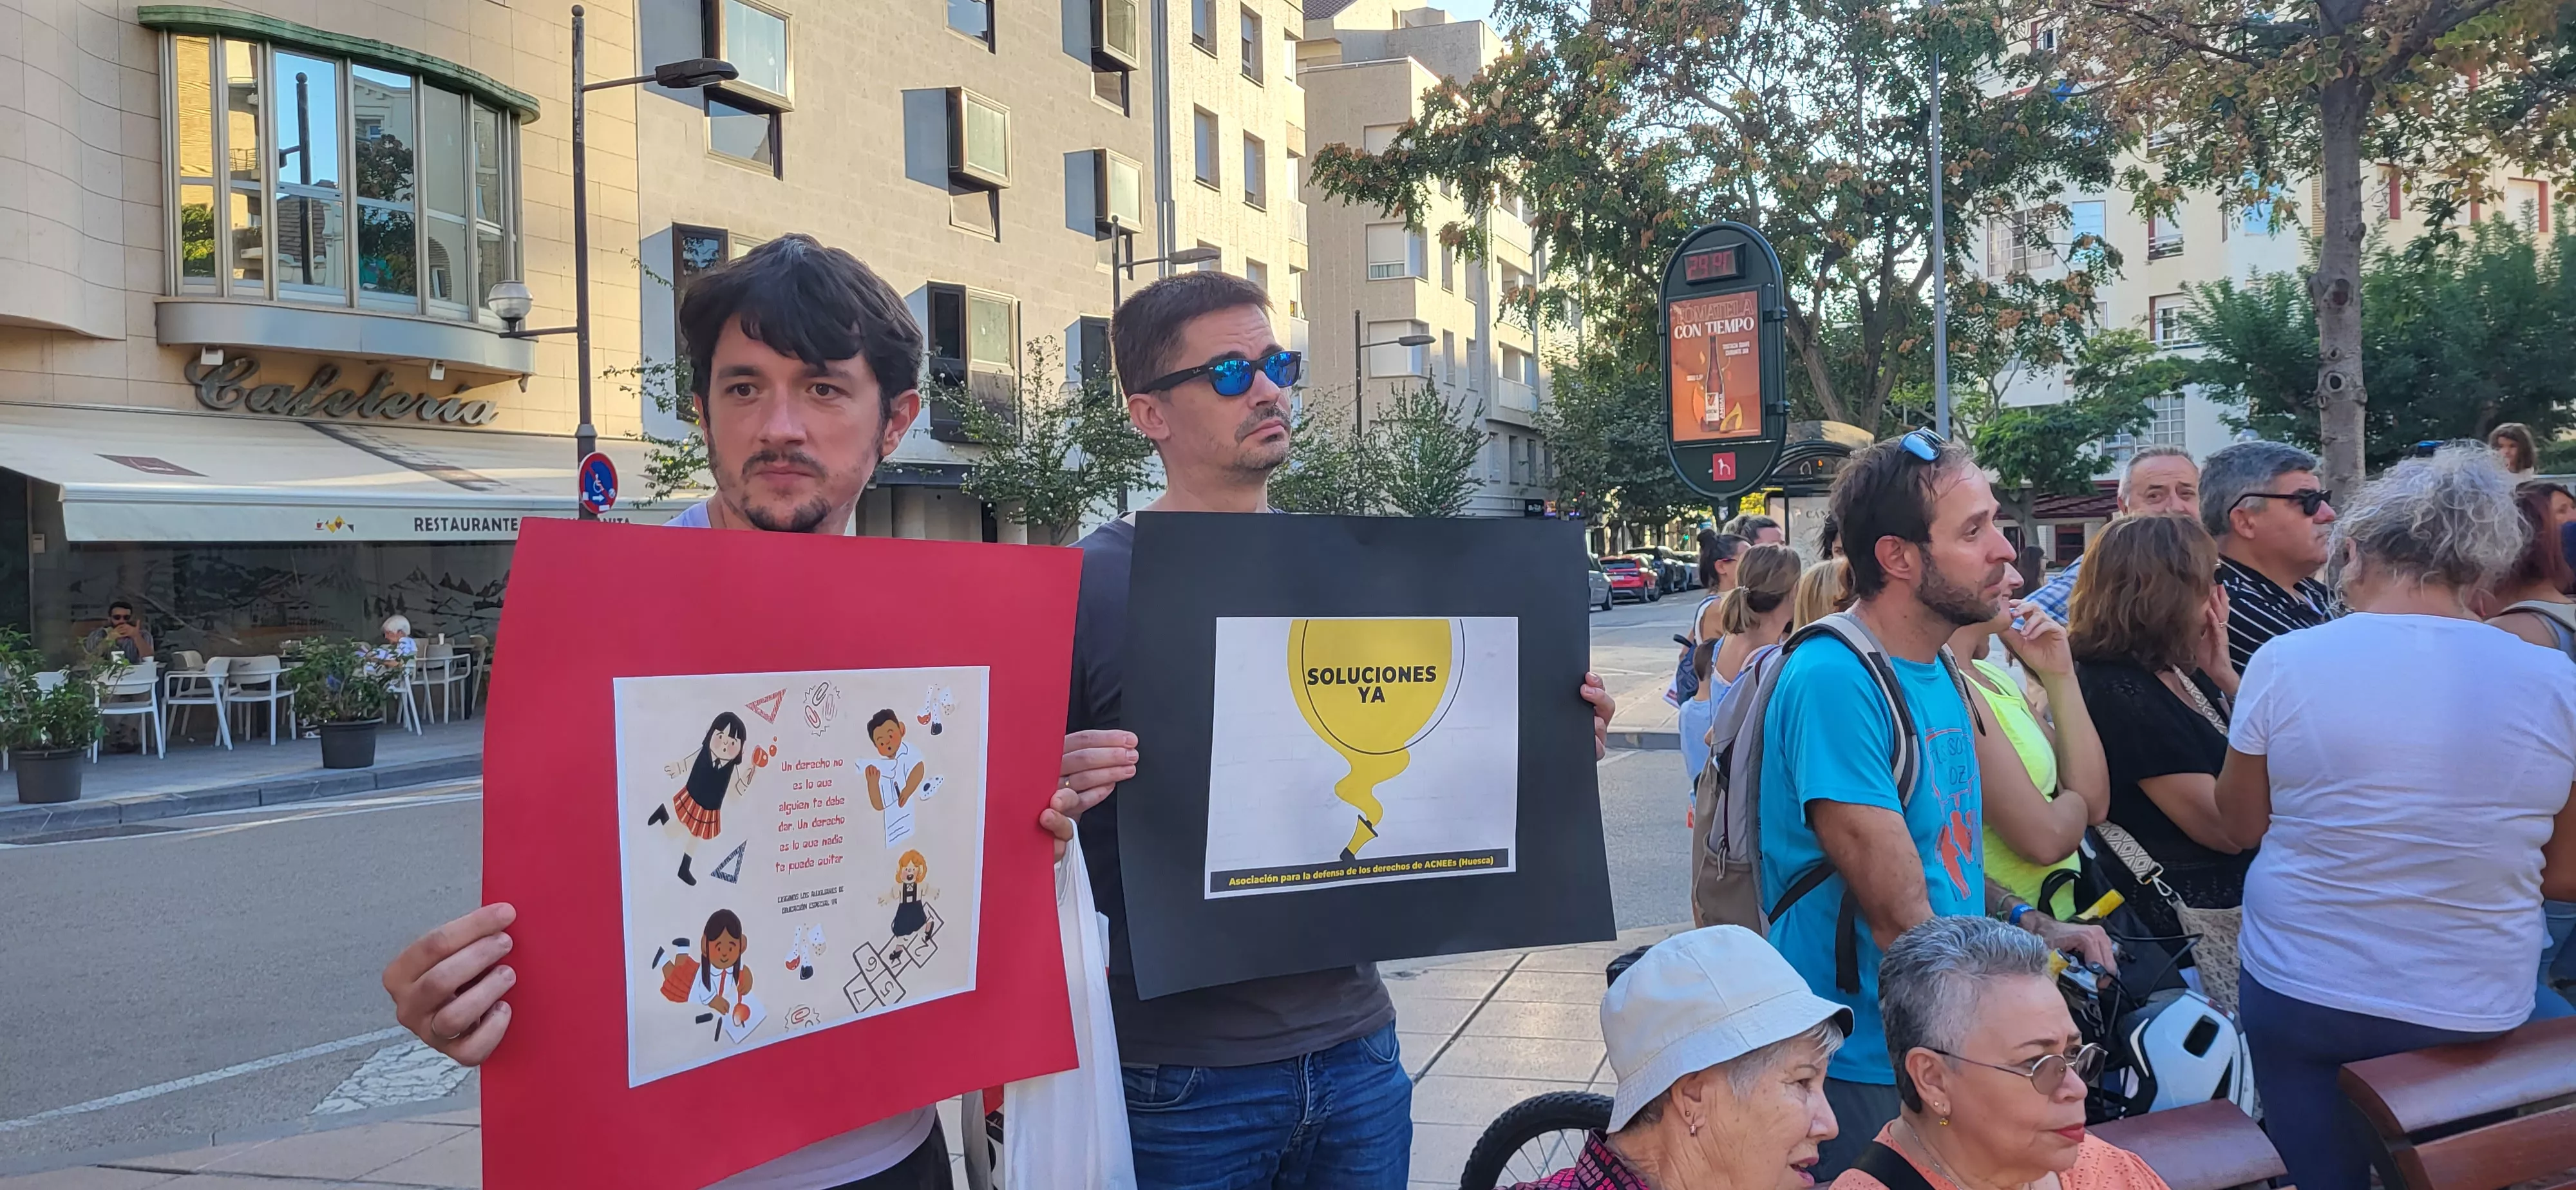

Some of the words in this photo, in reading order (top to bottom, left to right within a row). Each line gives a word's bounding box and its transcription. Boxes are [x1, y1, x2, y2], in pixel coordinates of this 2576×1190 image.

[1674, 323, 1701, 339] CON
[1705, 316, 1754, 335] TIEMPO
[414, 516, 518, 532] RESTAURANTE
[1307, 665, 1437, 686] SOLUCIONES
[1358, 686, 1386, 703] YA
[781, 760, 792, 772] Un
[795, 757, 830, 771] derecho
[833, 759, 844, 768] no
[793, 782, 802, 790] es
[806, 779, 813, 789] lo
[817, 779, 832, 788] que
[779, 800, 810, 816] alguien
[813, 797, 822, 808] te
[826, 795, 845, 807] debe
[797, 818, 808, 829] Un
[811, 814, 845, 828] derecho
[779, 844, 790, 852] es
[792, 840, 800, 851] lo
[802, 839, 819, 849] que
[821, 834, 843, 846] nadie
[775, 862, 786, 873] te
[788, 857, 815, 875] puede
[817, 854, 843, 866] quitar
[1229, 874, 1278, 886] Asociación
[1280, 873, 1301, 883] para
[1303, 872, 1311, 880] la
[1312, 869, 1345, 880] defensa
[1346, 867, 1357, 875] de
[1358, 865, 1371, 874] los
[1372, 862, 1410, 873] derechos
[1412, 861, 1423, 870] de
[1424, 859, 1457, 869] ACNEEs
[1459, 855, 1494, 868] (Huesca)
